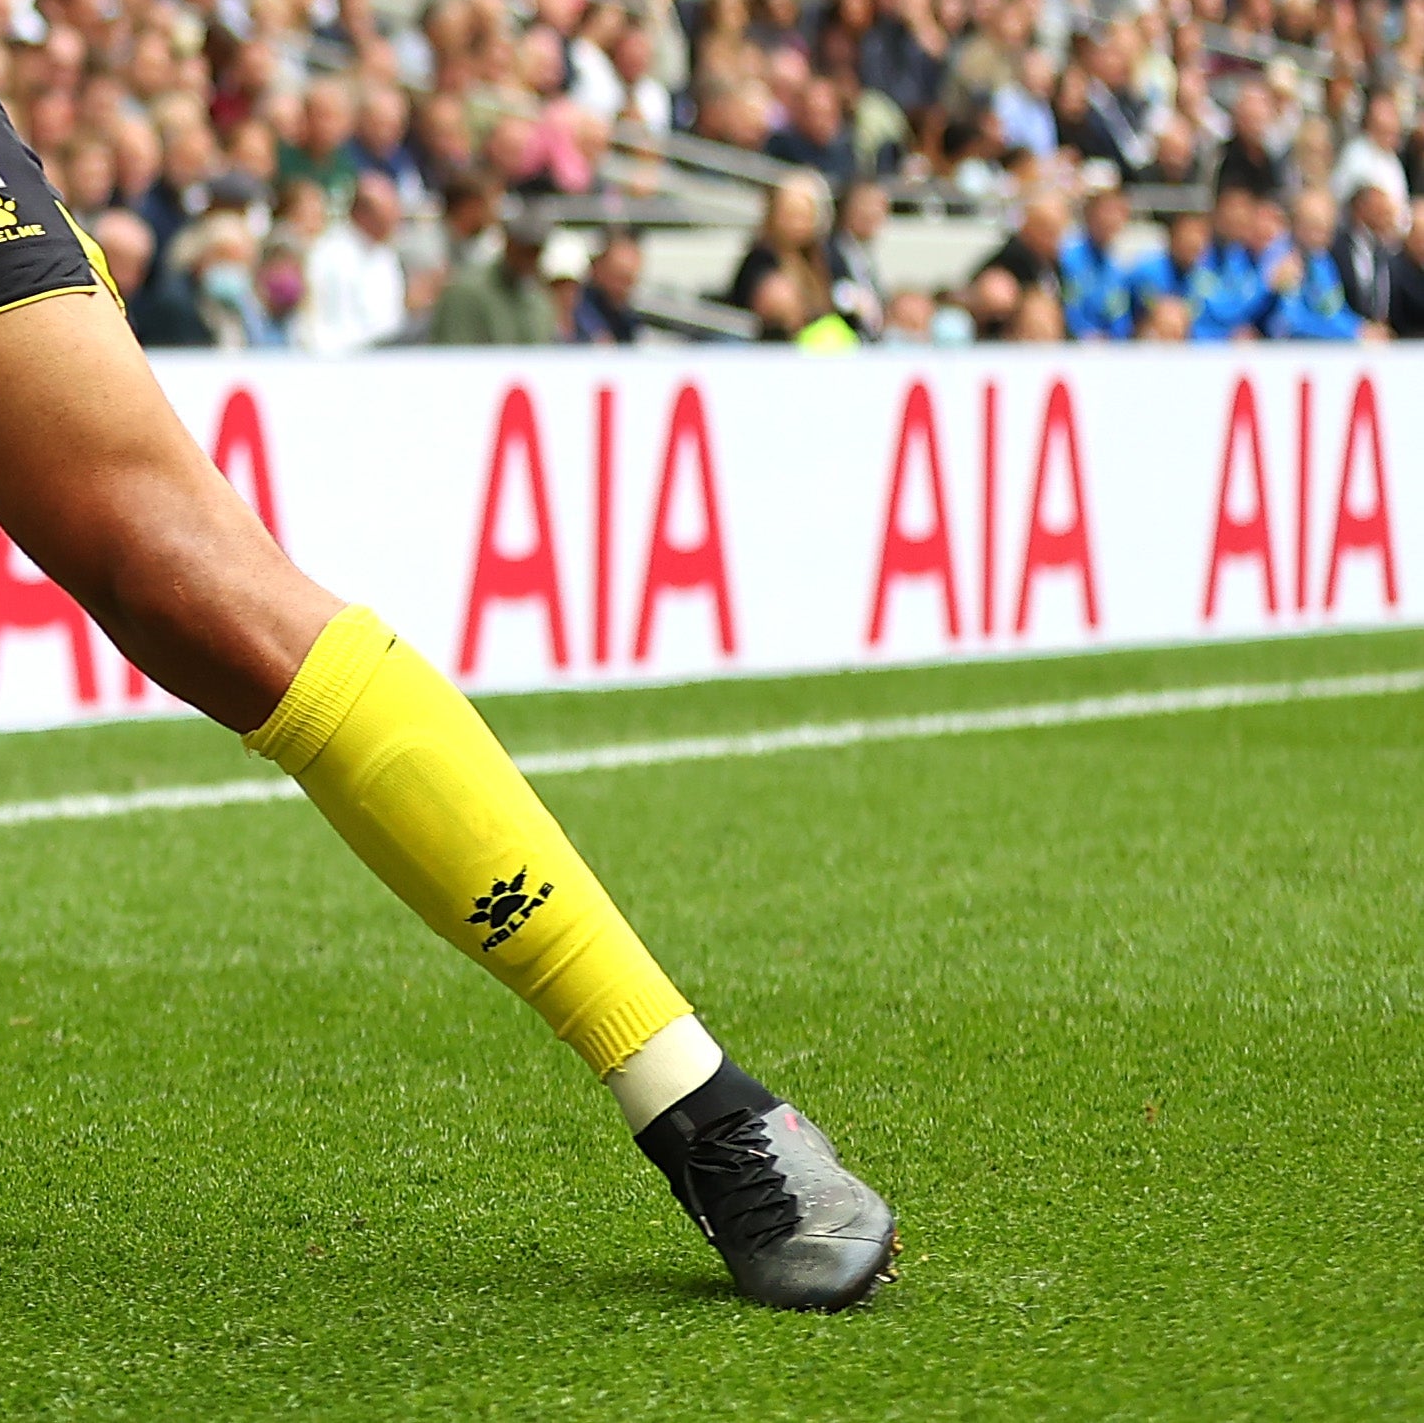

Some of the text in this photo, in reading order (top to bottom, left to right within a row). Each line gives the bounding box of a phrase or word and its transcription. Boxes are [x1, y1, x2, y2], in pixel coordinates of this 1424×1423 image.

[456, 384, 737, 677] AIA
[866, 379, 1100, 647] AIA
[1202, 376, 1399, 619] AIA
[481, 882, 555, 953] KELME
